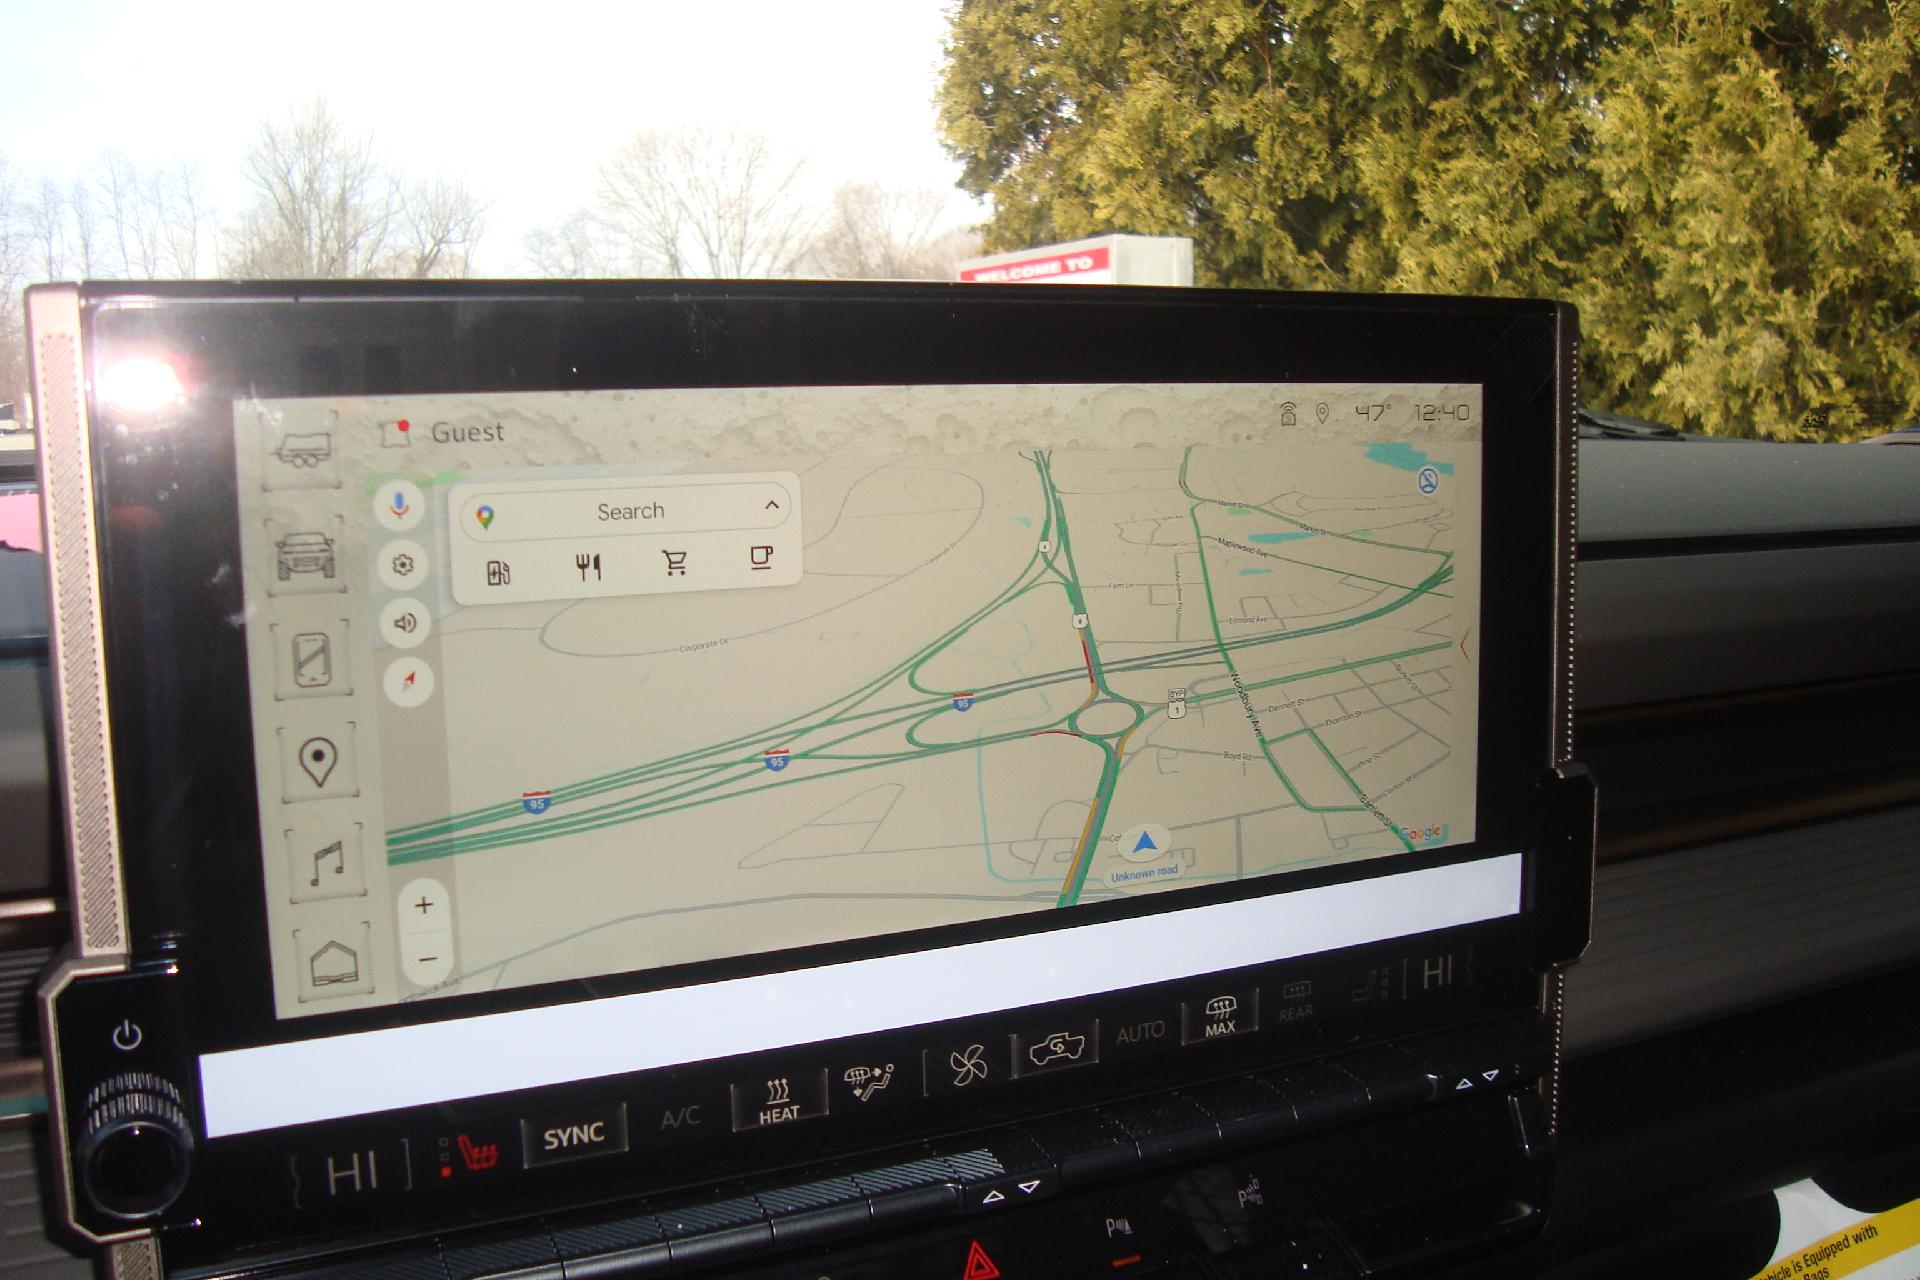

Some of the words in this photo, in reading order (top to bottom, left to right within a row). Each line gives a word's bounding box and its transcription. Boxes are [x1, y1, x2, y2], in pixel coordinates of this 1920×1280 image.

[1066, 256, 1093, 271] TO
[1414, 404, 1470, 421] 12:40
[432, 421, 505, 444] Guest
[598, 502, 665, 522] Search
[1218, 536, 1254, 553] Maplewood
[1229, 616, 1254, 624] Edmond
[680, 642, 718, 652] Corporate
[958, 699, 969, 708] 95
[1231, 671, 1254, 719] Woodbury
[1252, 720, 1262, 738] Ave
[1268, 701, 1296, 713] Dennett
[771, 757, 784, 767] 95
[530, 799, 545, 810] 95
[1399, 823, 1441, 841] Google
[1111, 869, 1155, 883] Unknown
[1157, 863, 1178, 876] road
[1424, 955, 1454, 990] HI
[1279, 1003, 1314, 1023] REAR
[1116, 1019, 1166, 1045] AUTO
[1205, 1020, 1236, 1039] MAX
[660, 1105, 701, 1130] A/C
[759, 1104, 800, 1126] HEAT
[544, 1120, 605, 1151] SYNC
[327, 1149, 377, 1195] HI
[1792, 1260, 1803, 1274] is
[1802, 1235, 1850, 1268] Equipped
[1852, 1224, 1879, 1244] with
[1803, 1267, 1830, 1280] Bags
